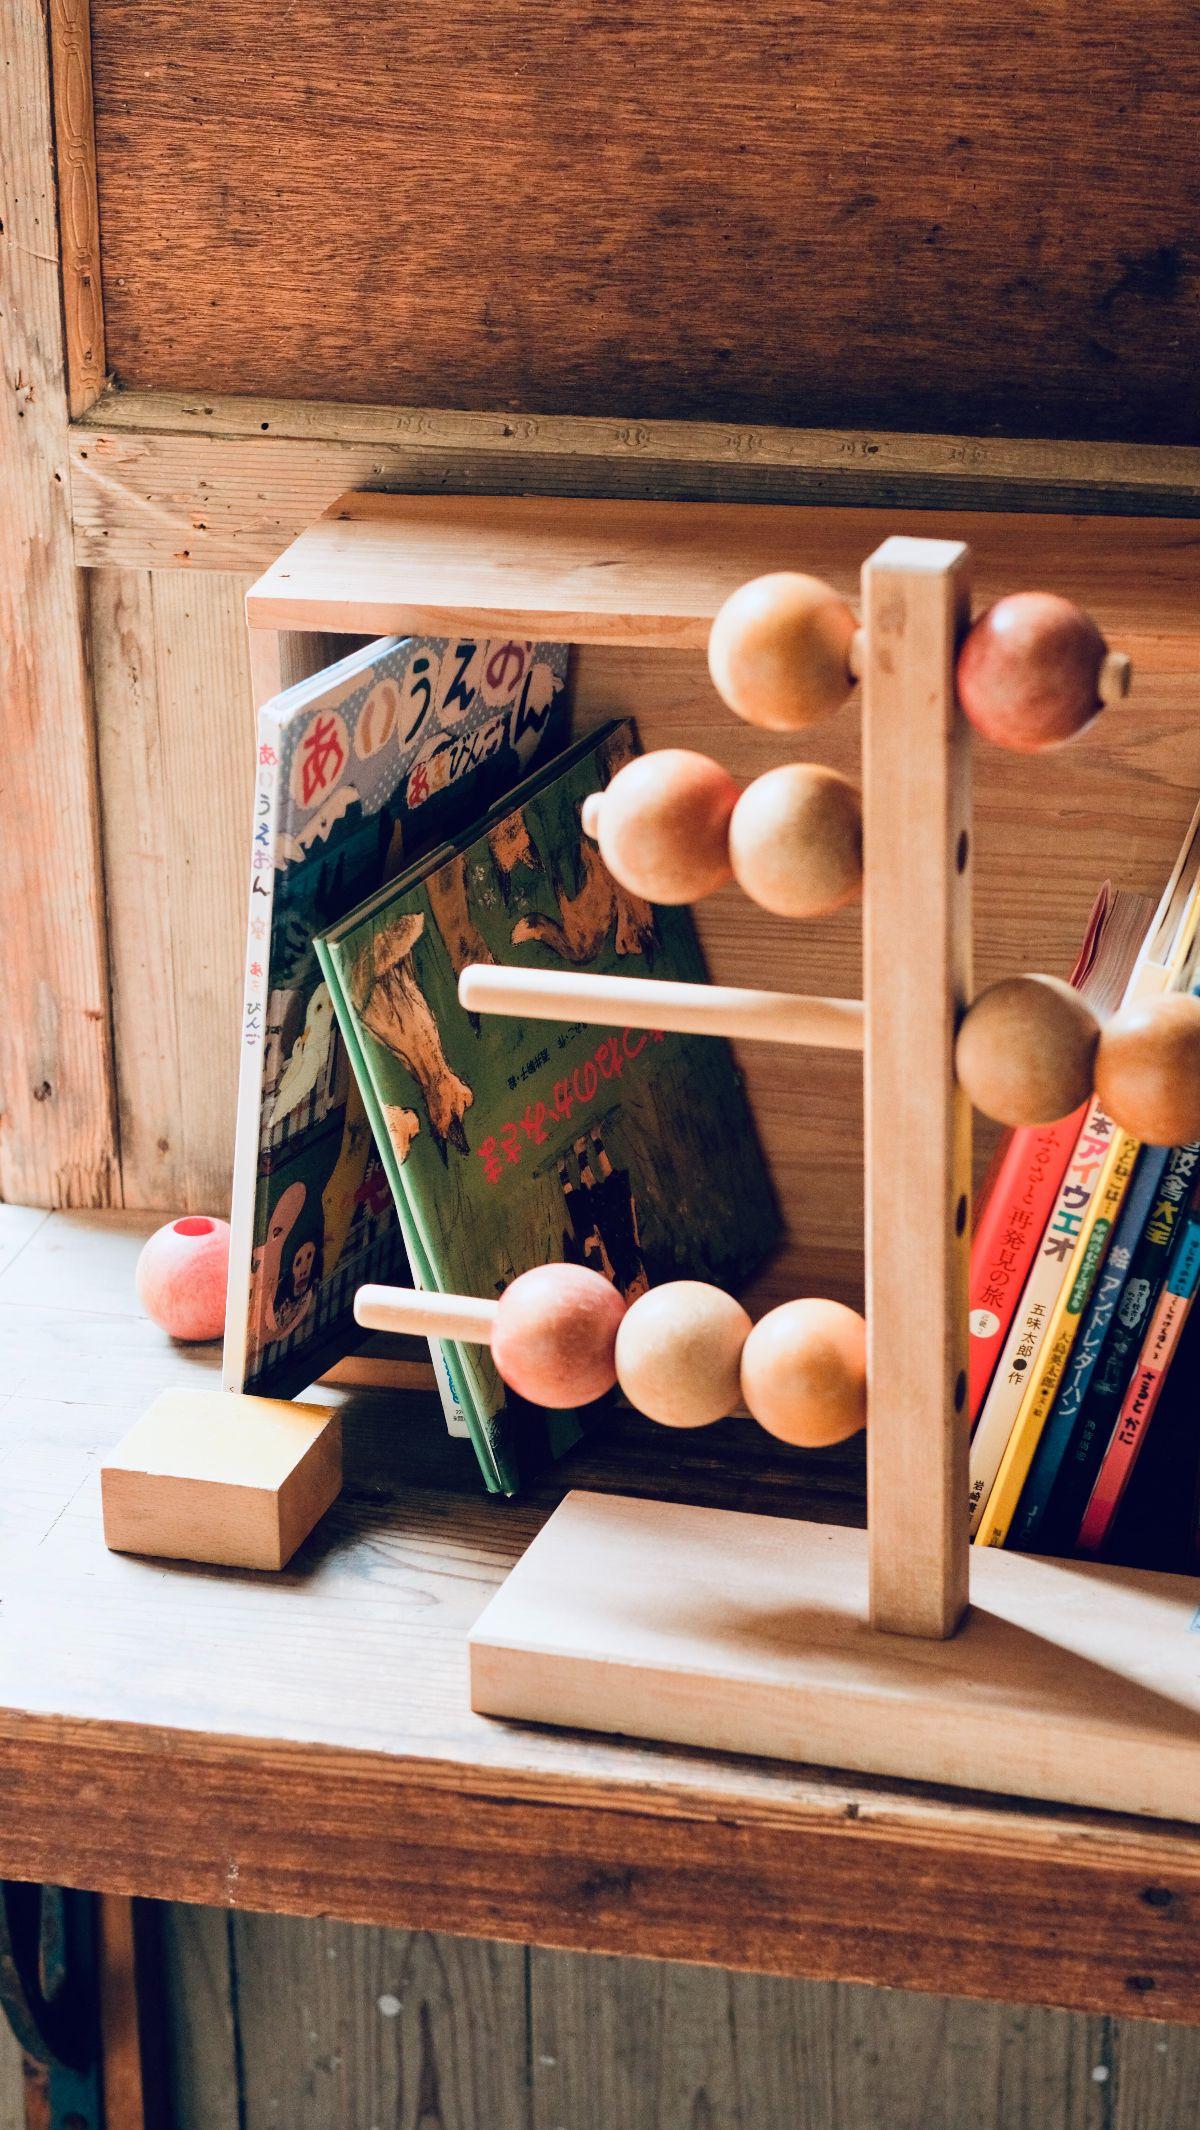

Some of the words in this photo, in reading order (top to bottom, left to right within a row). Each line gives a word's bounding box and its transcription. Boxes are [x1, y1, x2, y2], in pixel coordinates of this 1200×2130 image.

[476, 1026, 664, 1184] つねのかみさま
[1044, 1102, 1112, 1262] 本アイウエオ
